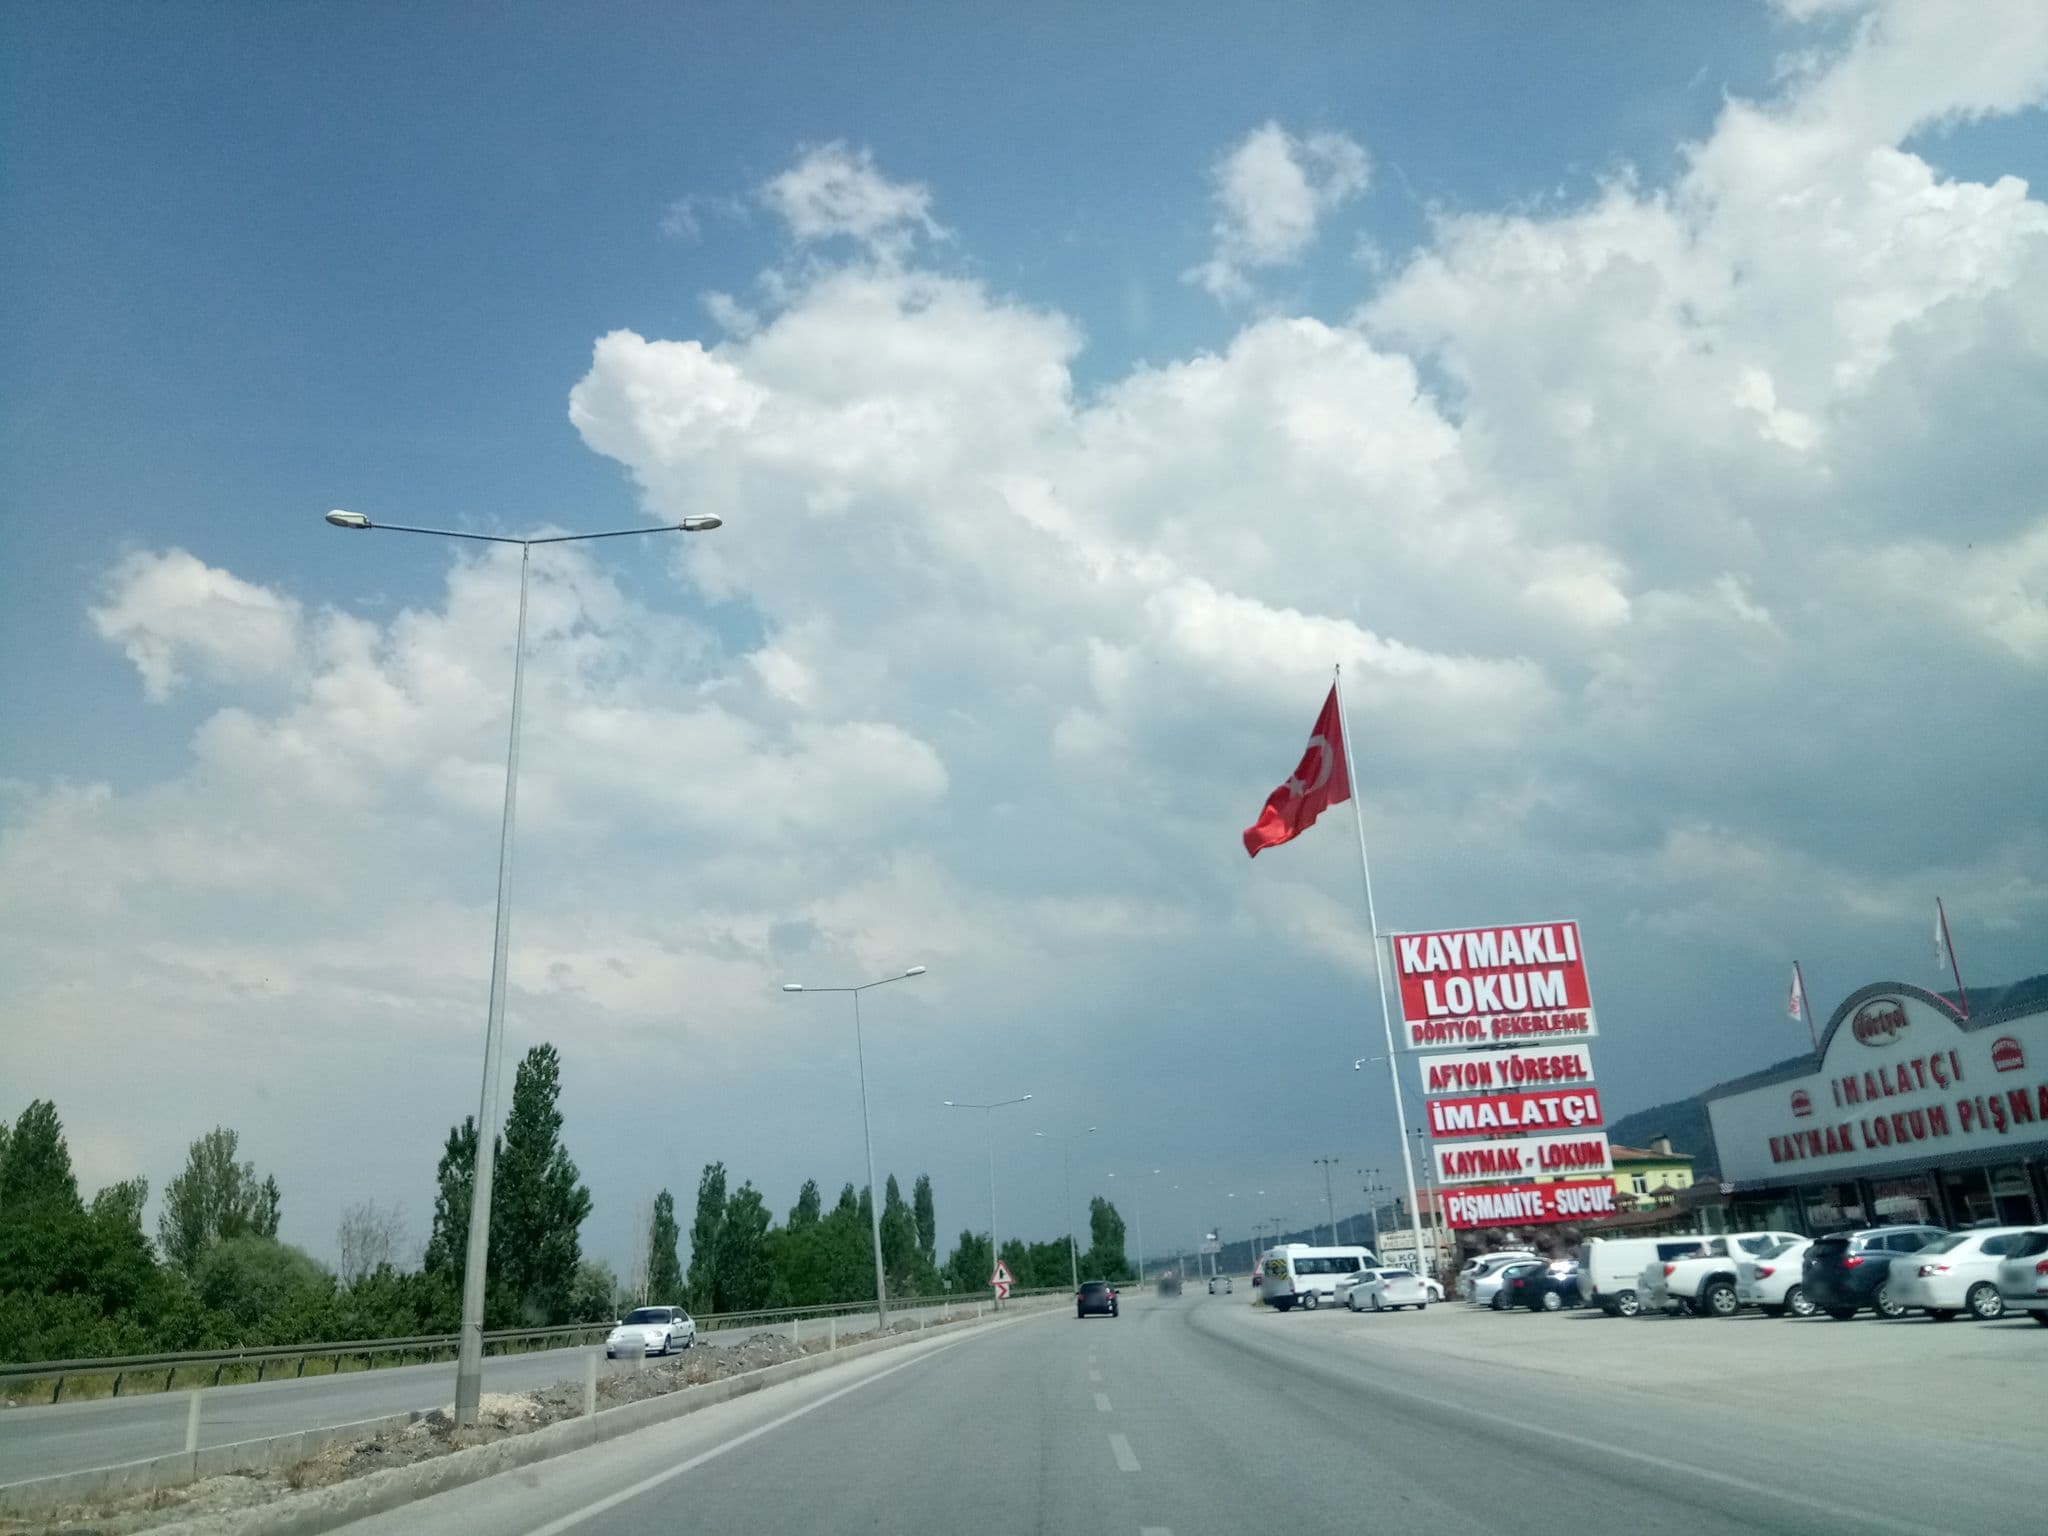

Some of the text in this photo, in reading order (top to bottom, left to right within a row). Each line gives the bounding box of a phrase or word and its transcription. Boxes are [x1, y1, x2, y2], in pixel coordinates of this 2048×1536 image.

[1400, 925, 1578, 974] KAYMAKLI
[1423, 970, 1568, 1016] LOKUM
[1411, 1012, 1589, 1043] DÖRTYOL ŞEKERLEME
[1429, 1054, 1588, 1089] AFYON YÖRESEL
[1831, 1048, 1963, 1108] İMALATÇI
[1432, 1094, 1598, 1132] İMALATÇI
[1860, 1104, 1949, 1149] LOKUM
[1441, 1146, 1522, 1176] KAYMAK
[1538, 1141, 1605, 1169] LOKUM
[1449, 1187, 1545, 1225] PİŞMANİYE
